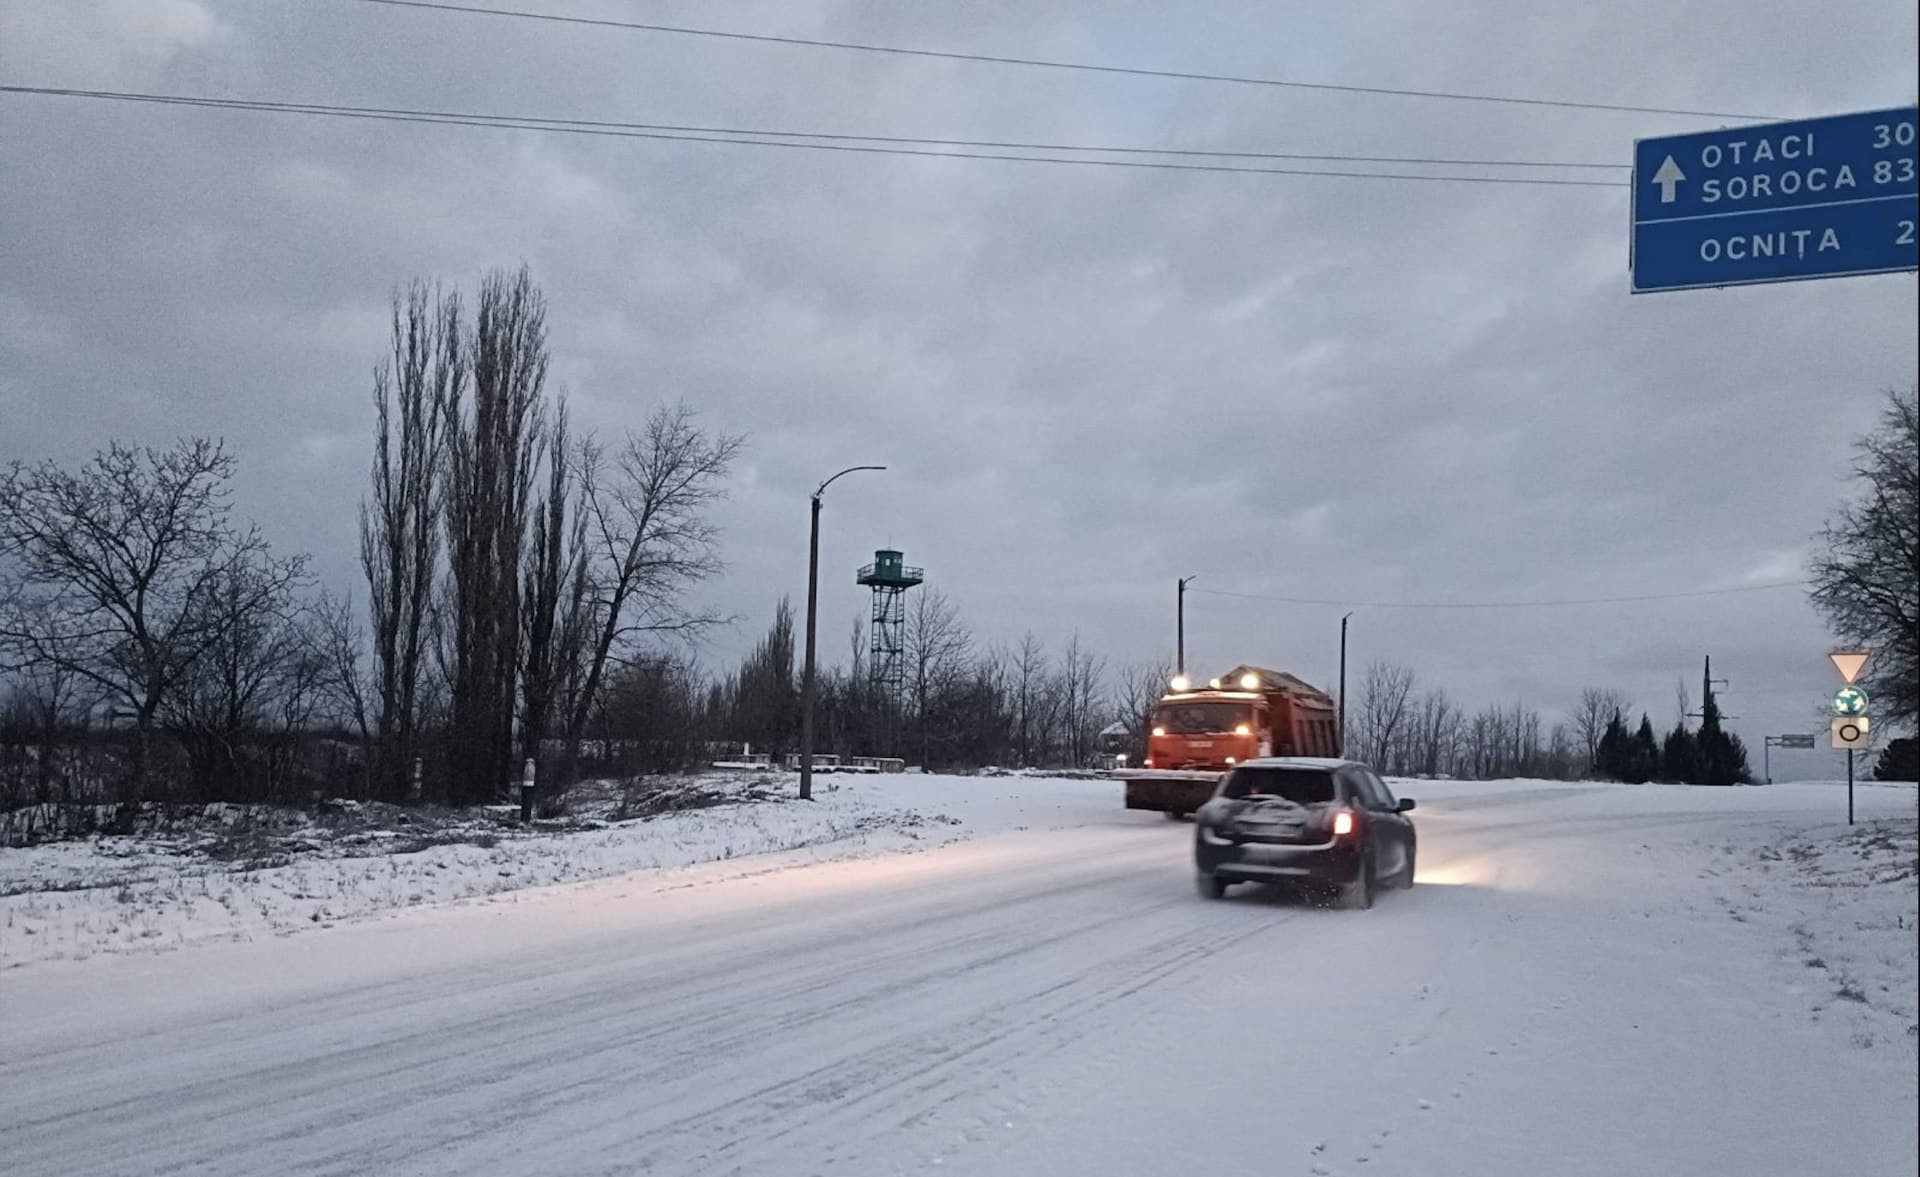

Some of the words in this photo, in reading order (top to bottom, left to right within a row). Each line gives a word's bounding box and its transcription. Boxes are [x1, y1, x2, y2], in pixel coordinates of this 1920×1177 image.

[1702, 133, 1814, 168] OTACI
[1873, 122, 1915, 149] 30
[1702, 165, 1857, 203] SOROCA
[1873, 158, 1915, 184] 83
[1895, 220, 1915, 245] 2
